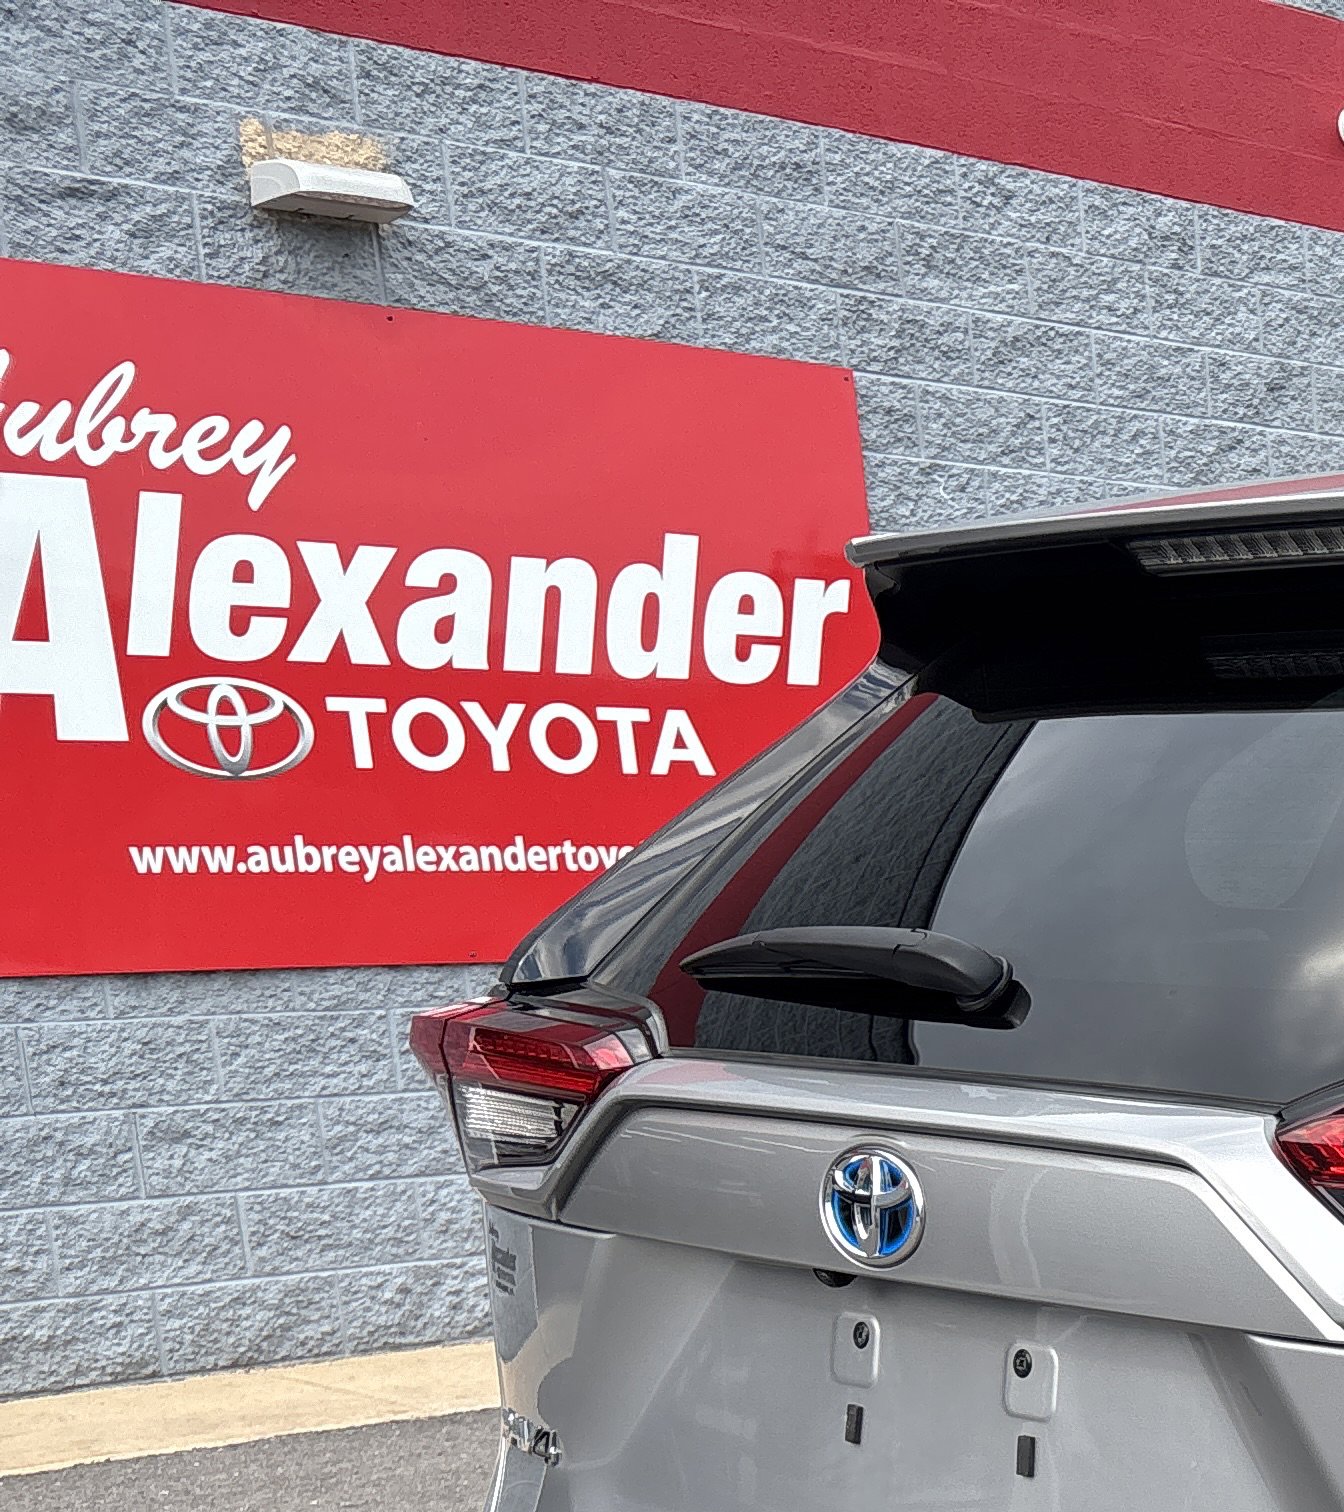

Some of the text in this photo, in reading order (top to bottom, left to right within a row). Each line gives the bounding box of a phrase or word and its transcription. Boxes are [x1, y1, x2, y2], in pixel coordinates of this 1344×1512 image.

[0, 348, 297, 511] ubrey
[0, 472, 851, 742] Alexander
[326, 696, 716, 777] TOYOTA
